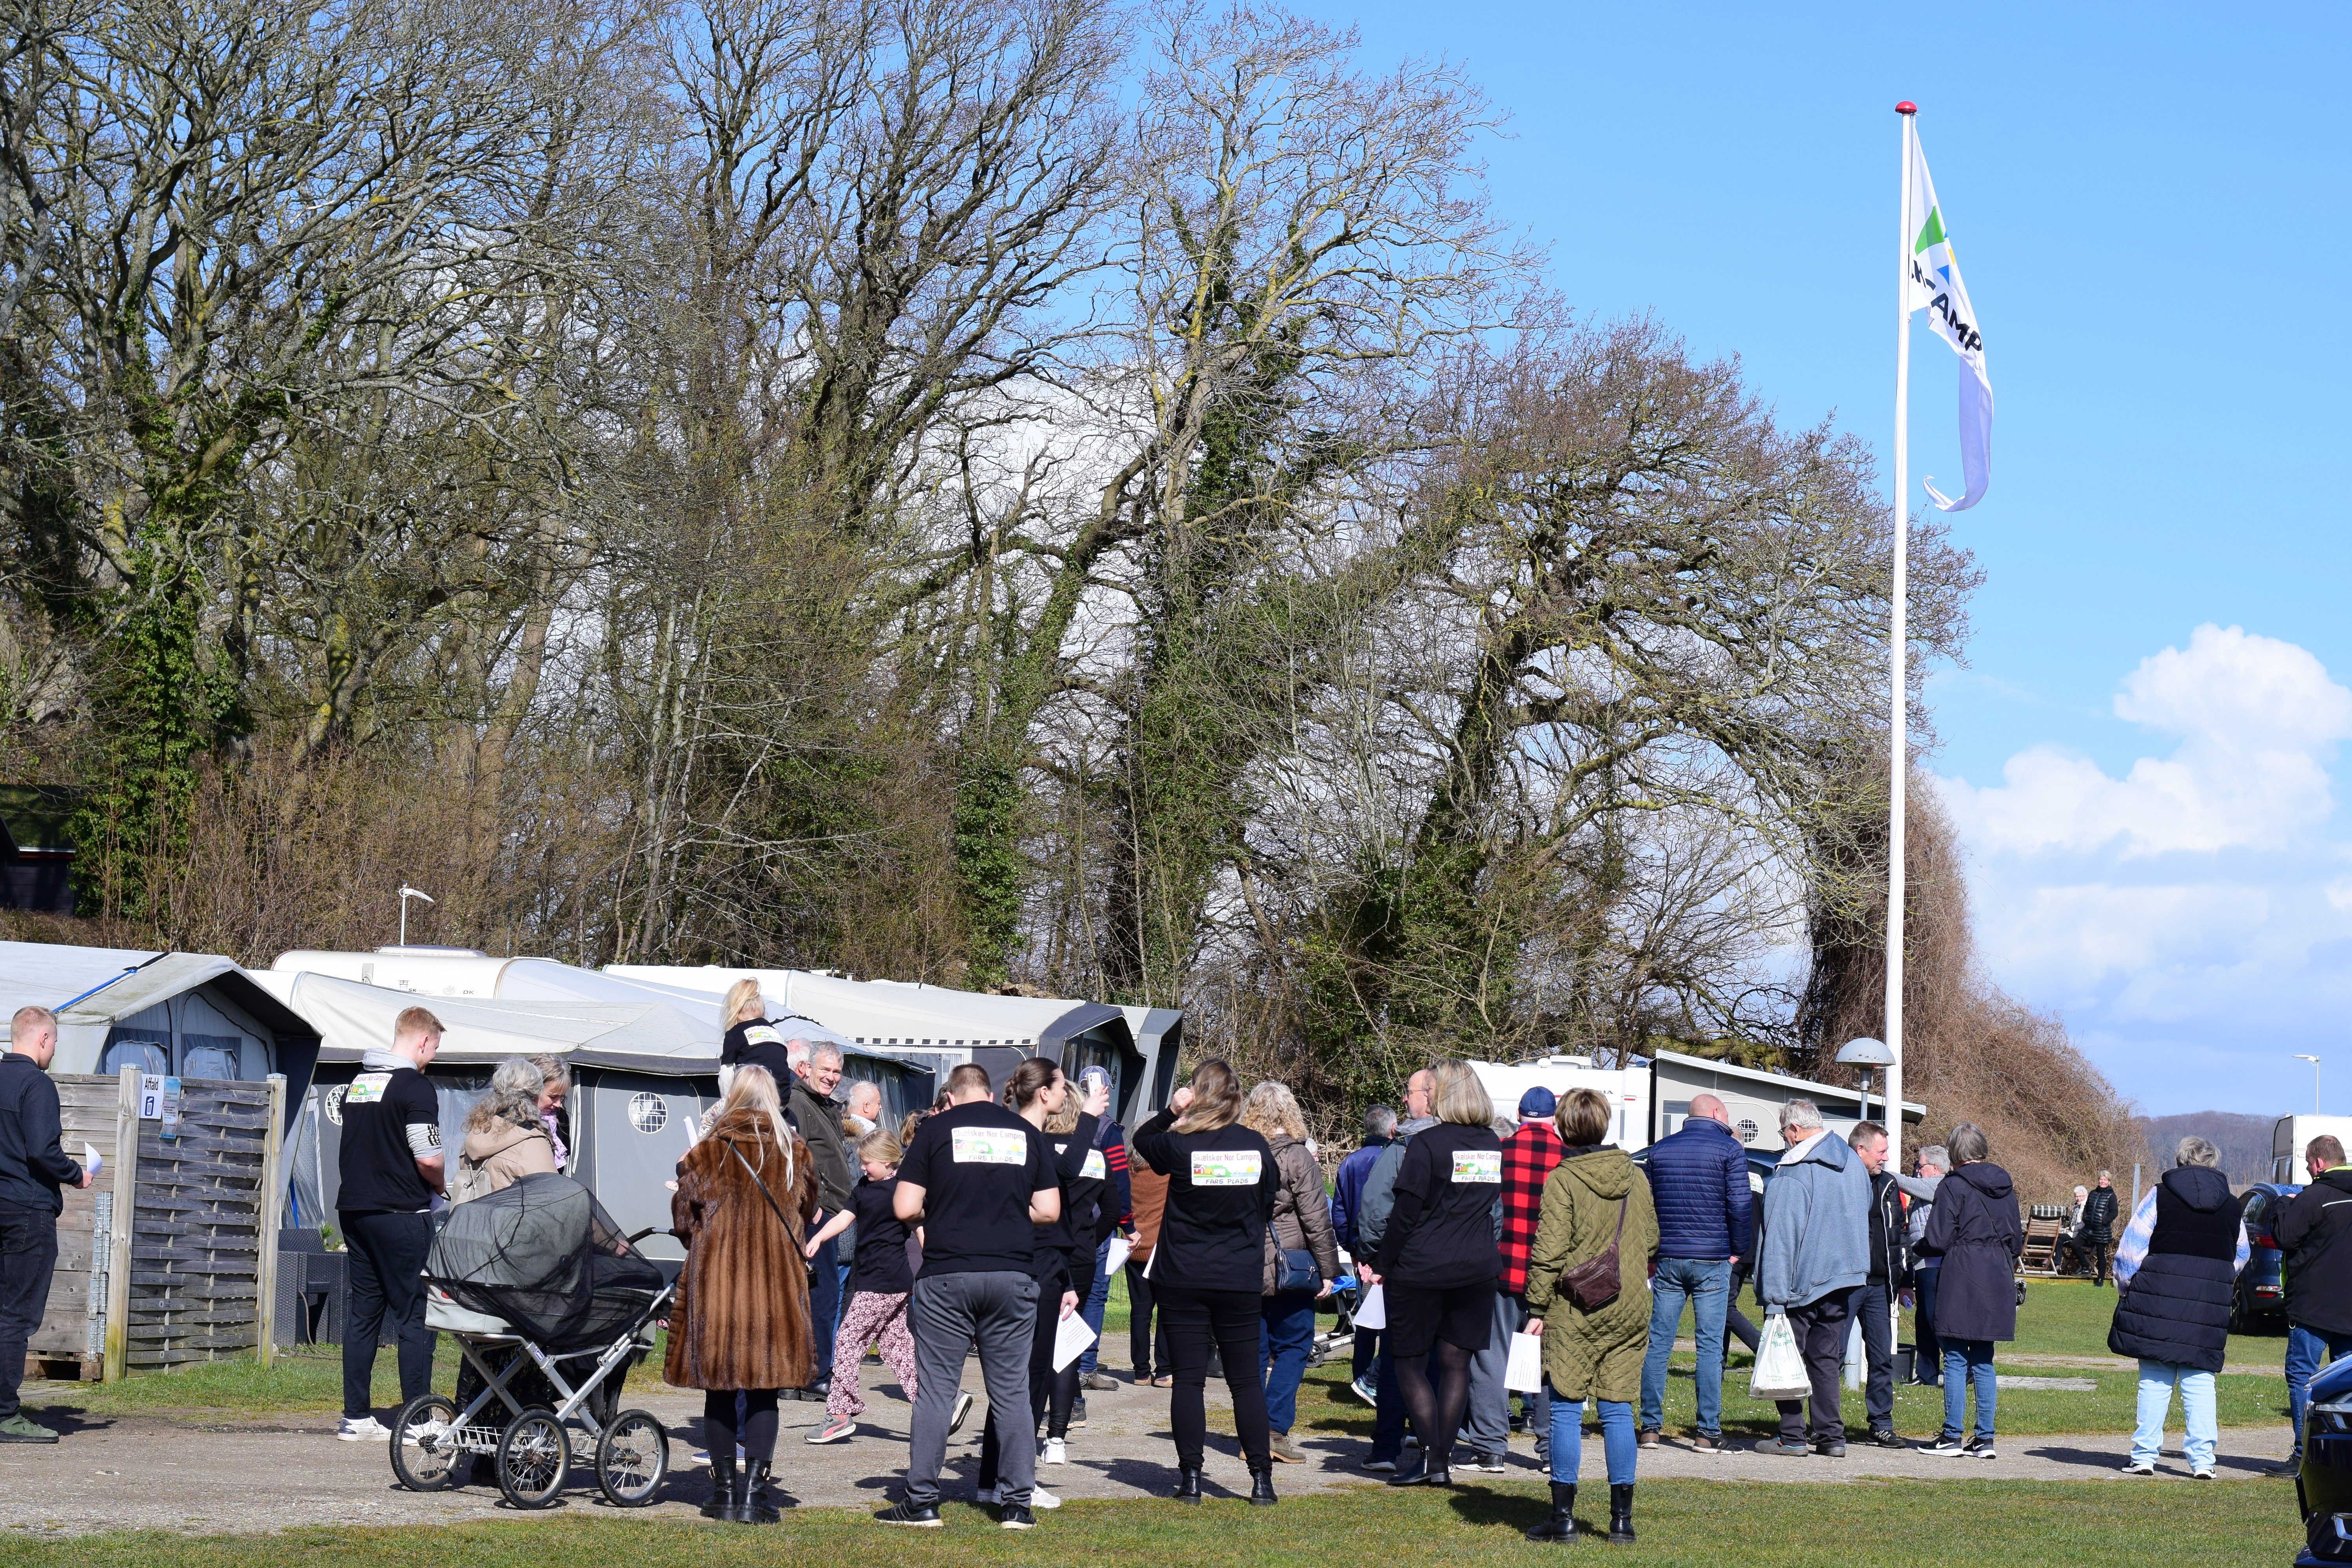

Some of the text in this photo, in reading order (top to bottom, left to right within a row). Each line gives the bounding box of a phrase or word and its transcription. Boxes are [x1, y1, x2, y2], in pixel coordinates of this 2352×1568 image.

[144, 1077, 159, 1091] Affald
[1000, 1131, 1025, 1142] Camping
[1236, 1153, 1260, 1162] Camping
